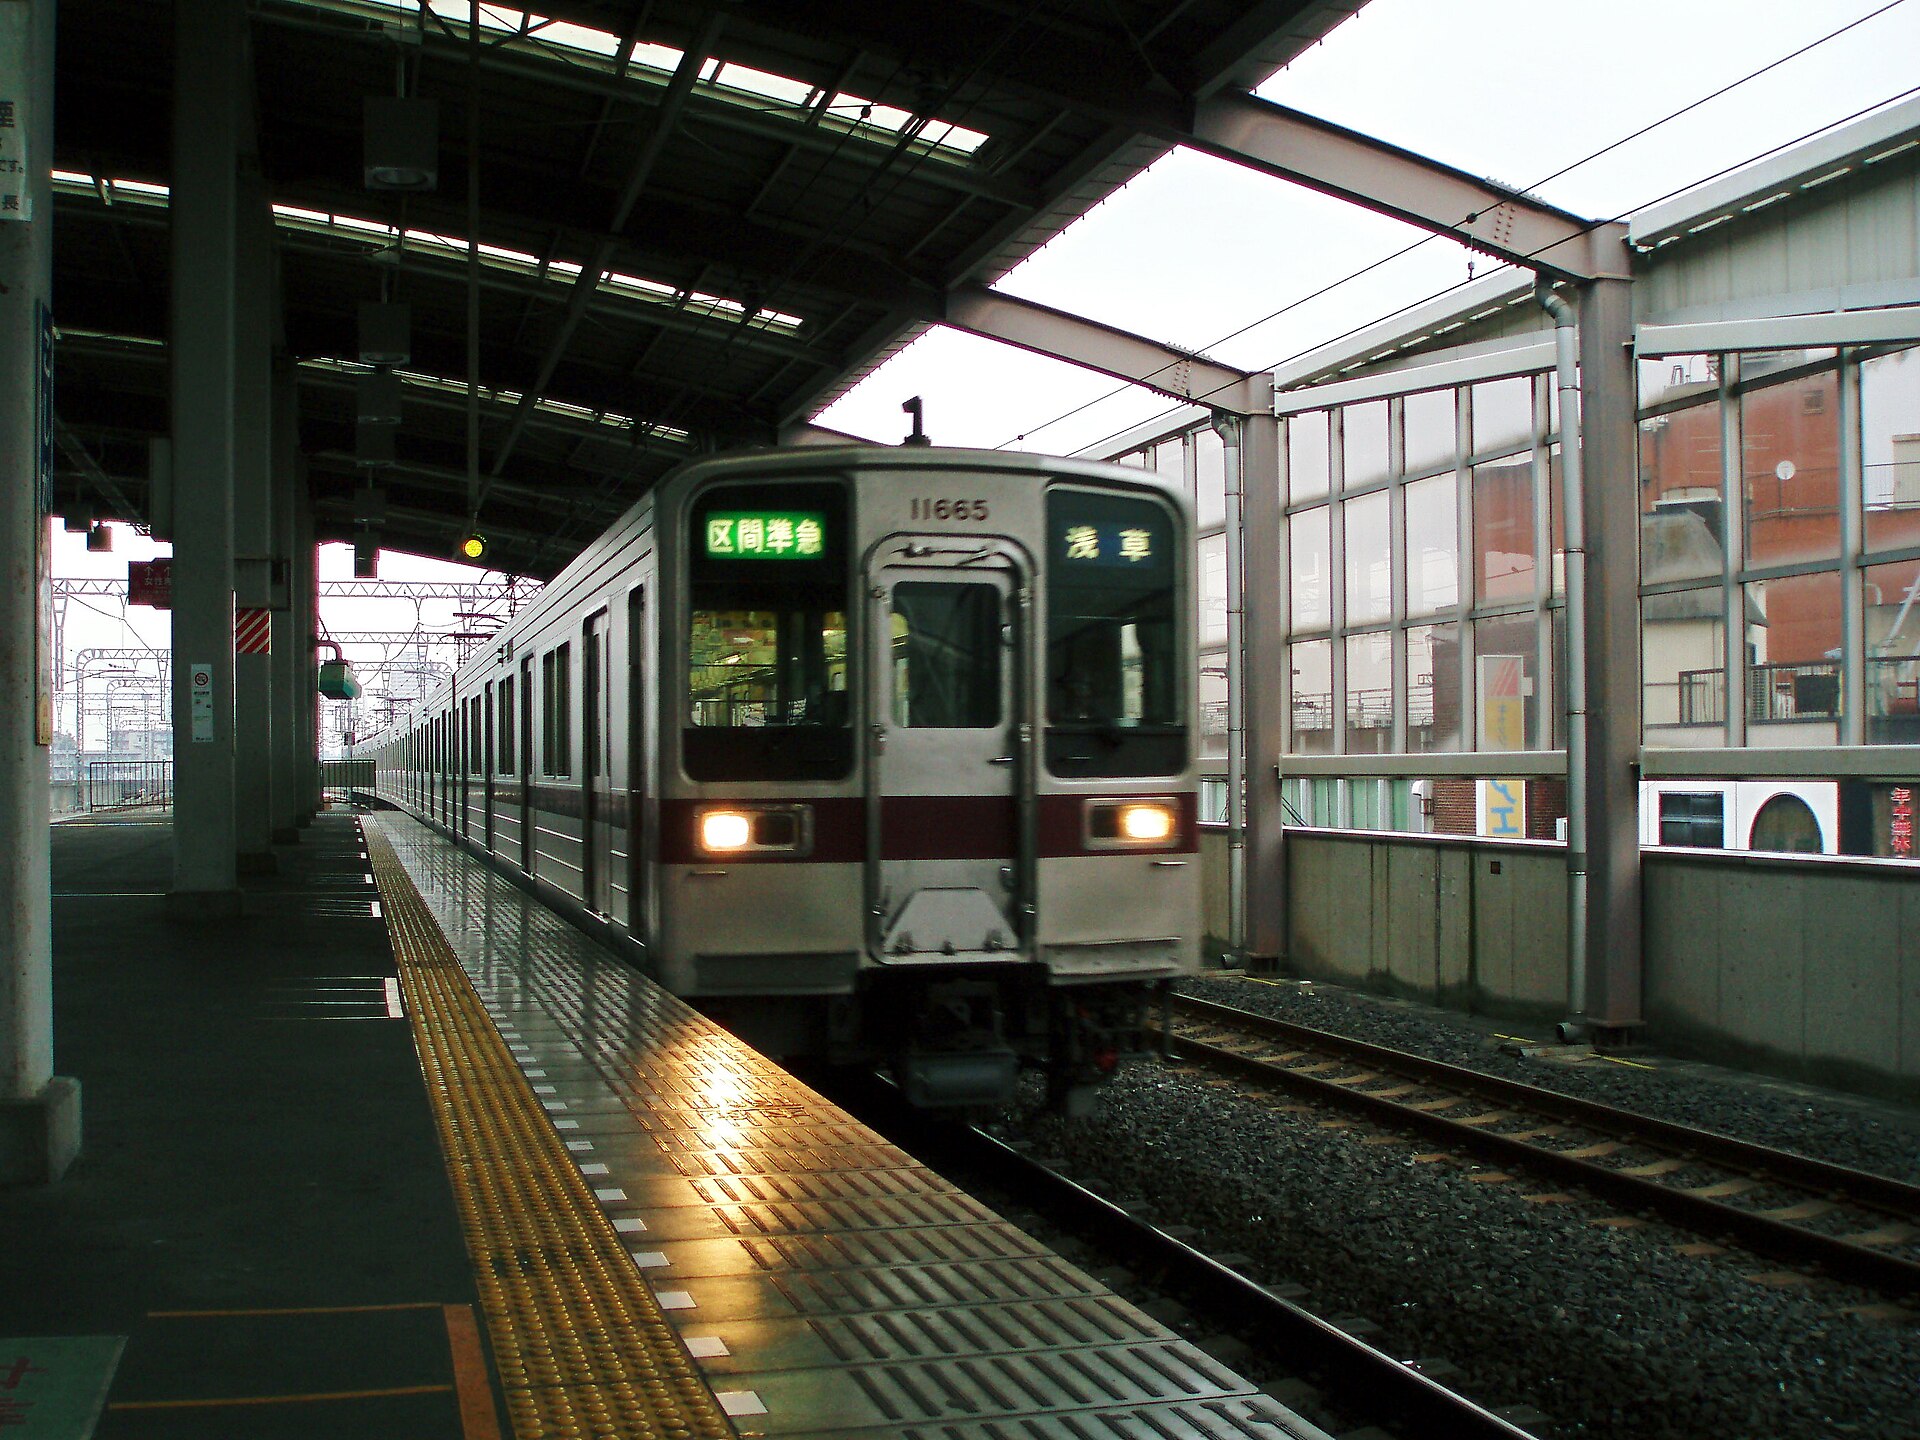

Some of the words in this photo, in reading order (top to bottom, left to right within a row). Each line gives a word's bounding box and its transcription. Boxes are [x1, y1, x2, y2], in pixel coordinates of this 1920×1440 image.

[911, 498, 990, 521] 11665
[707, 518, 822, 555] 区間準急
[1064, 525, 1152, 562] 浅草
[1890, 787, 1912, 853] 年中無休
